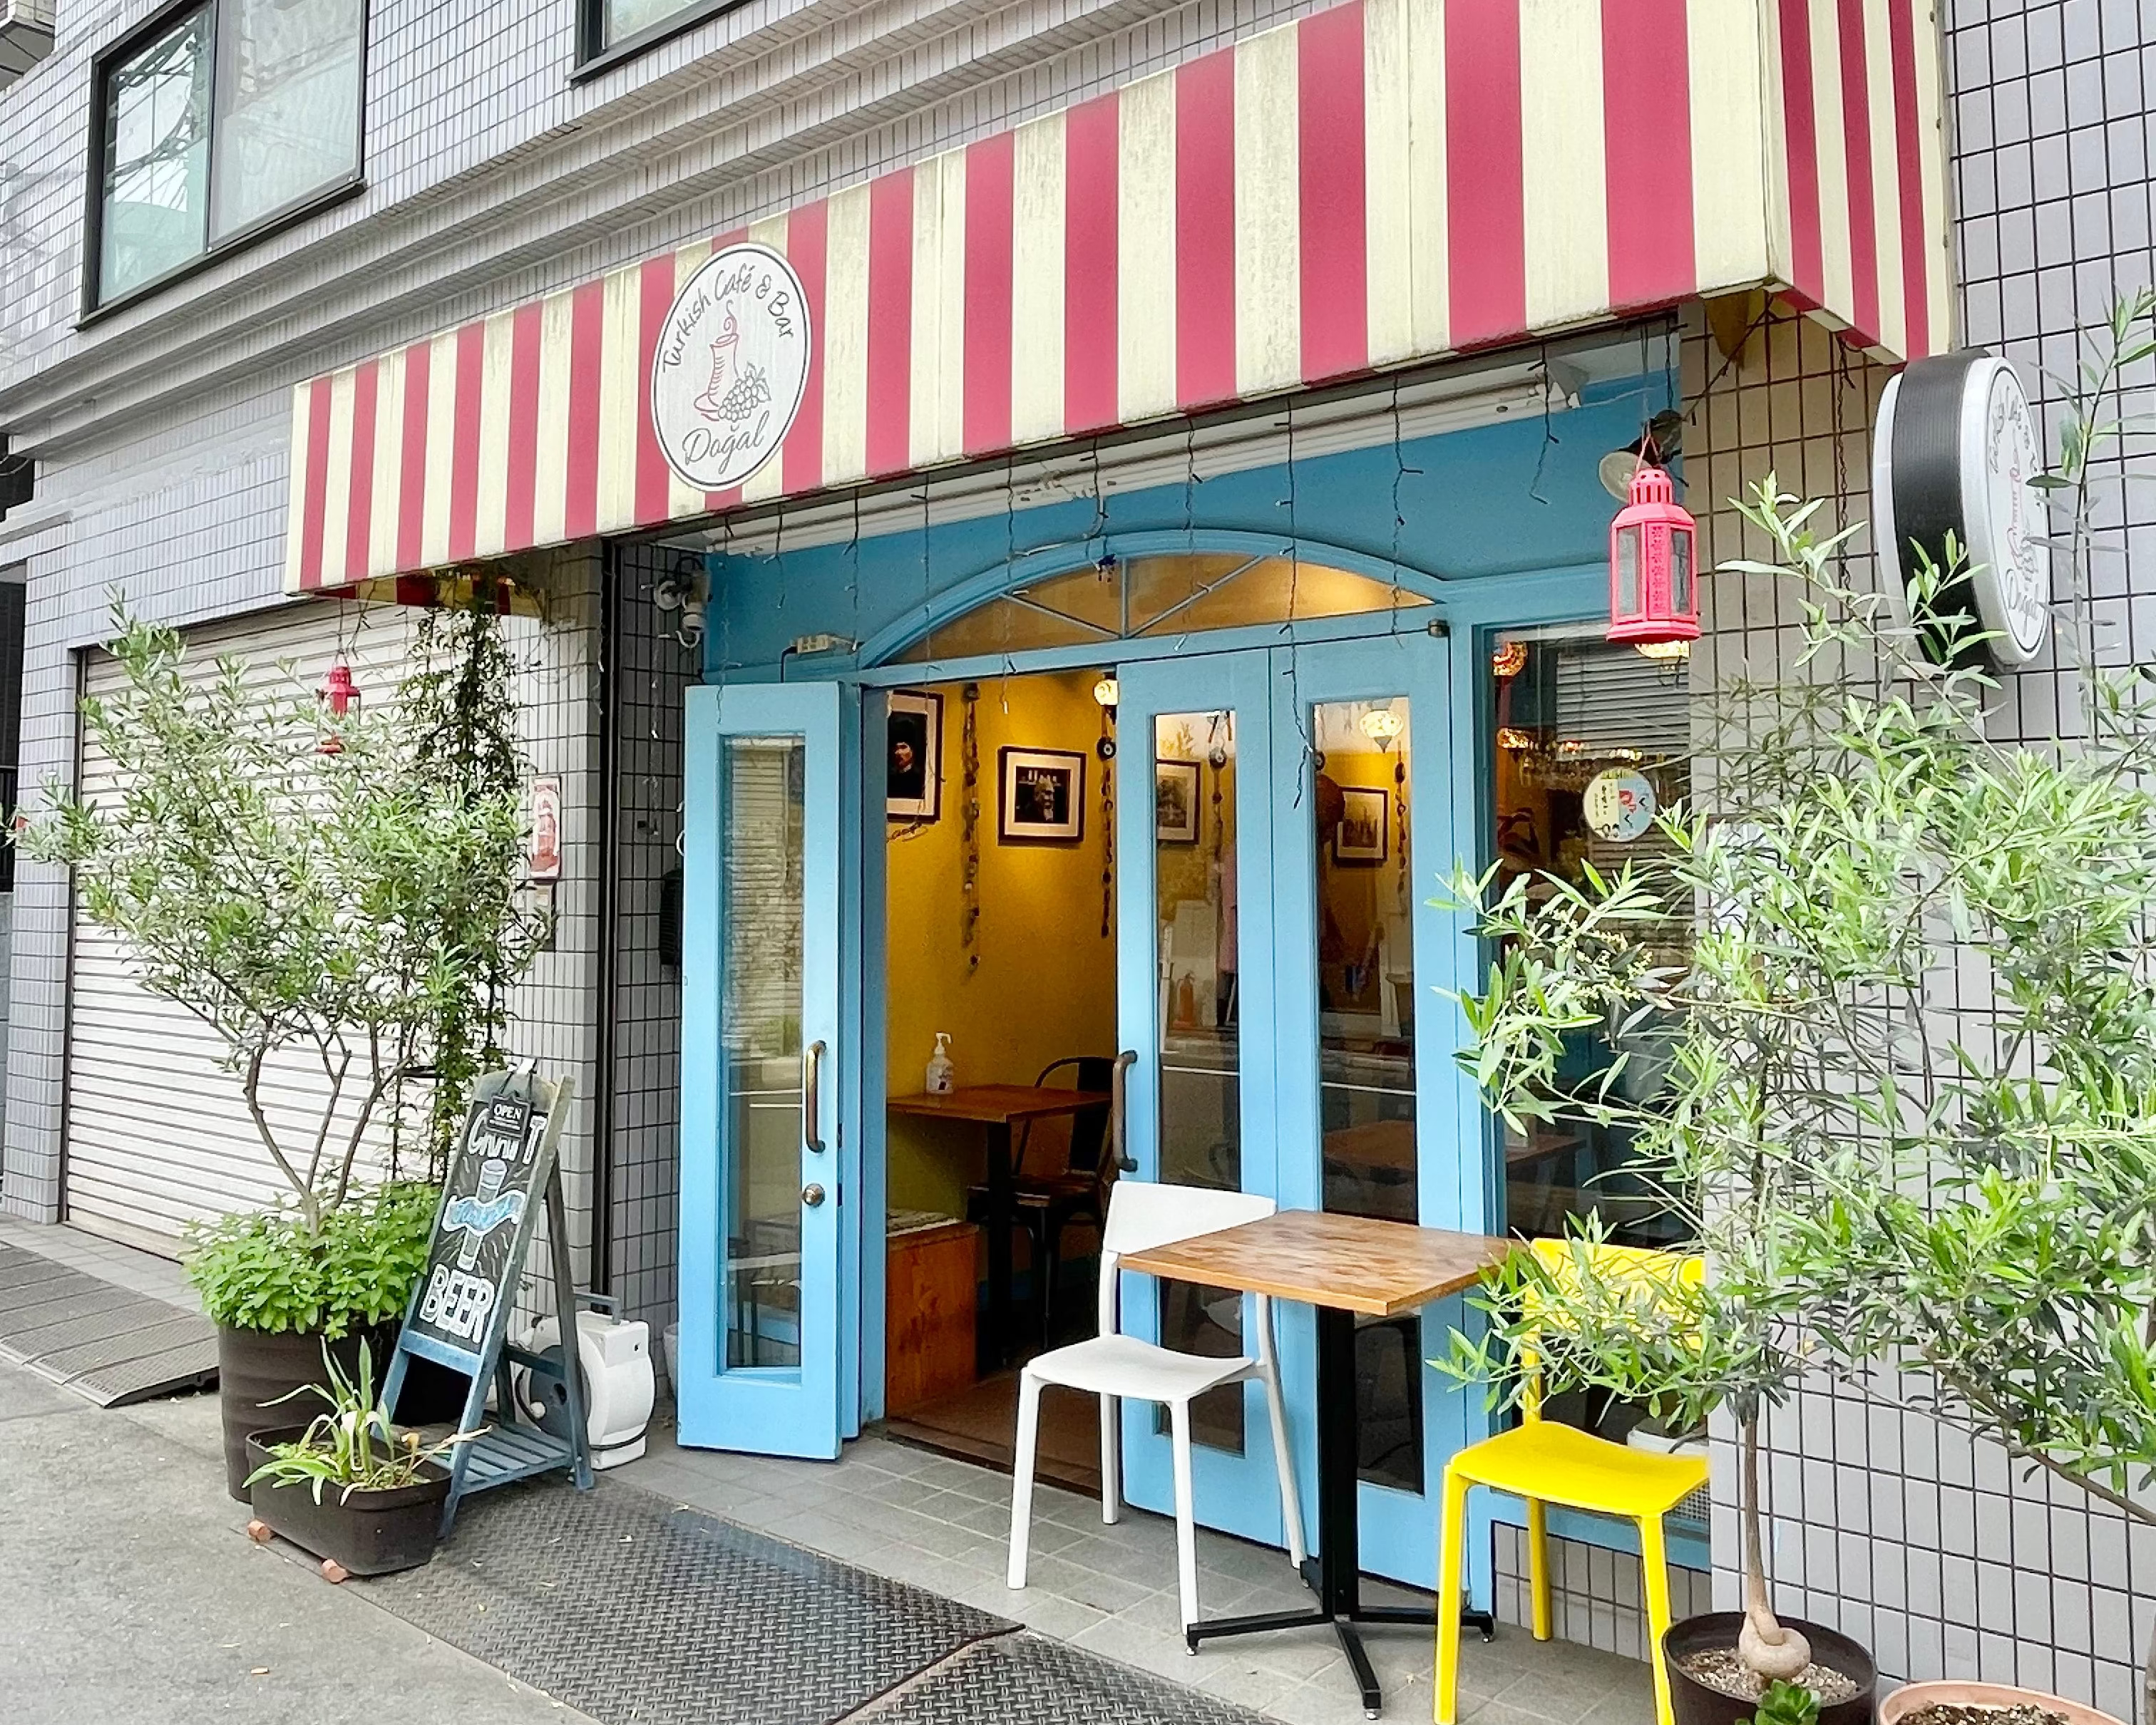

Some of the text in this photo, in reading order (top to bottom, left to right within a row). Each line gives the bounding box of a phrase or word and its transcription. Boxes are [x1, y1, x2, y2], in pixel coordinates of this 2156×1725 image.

[662, 287, 712, 374] Turkish
[714, 263, 756, 302] Café
[767, 290, 795, 339] Bar
[682, 410, 770, 475] Doğal
[493, 1103, 523, 1120] OPEN
[419, 1263, 496, 1344] BEER
